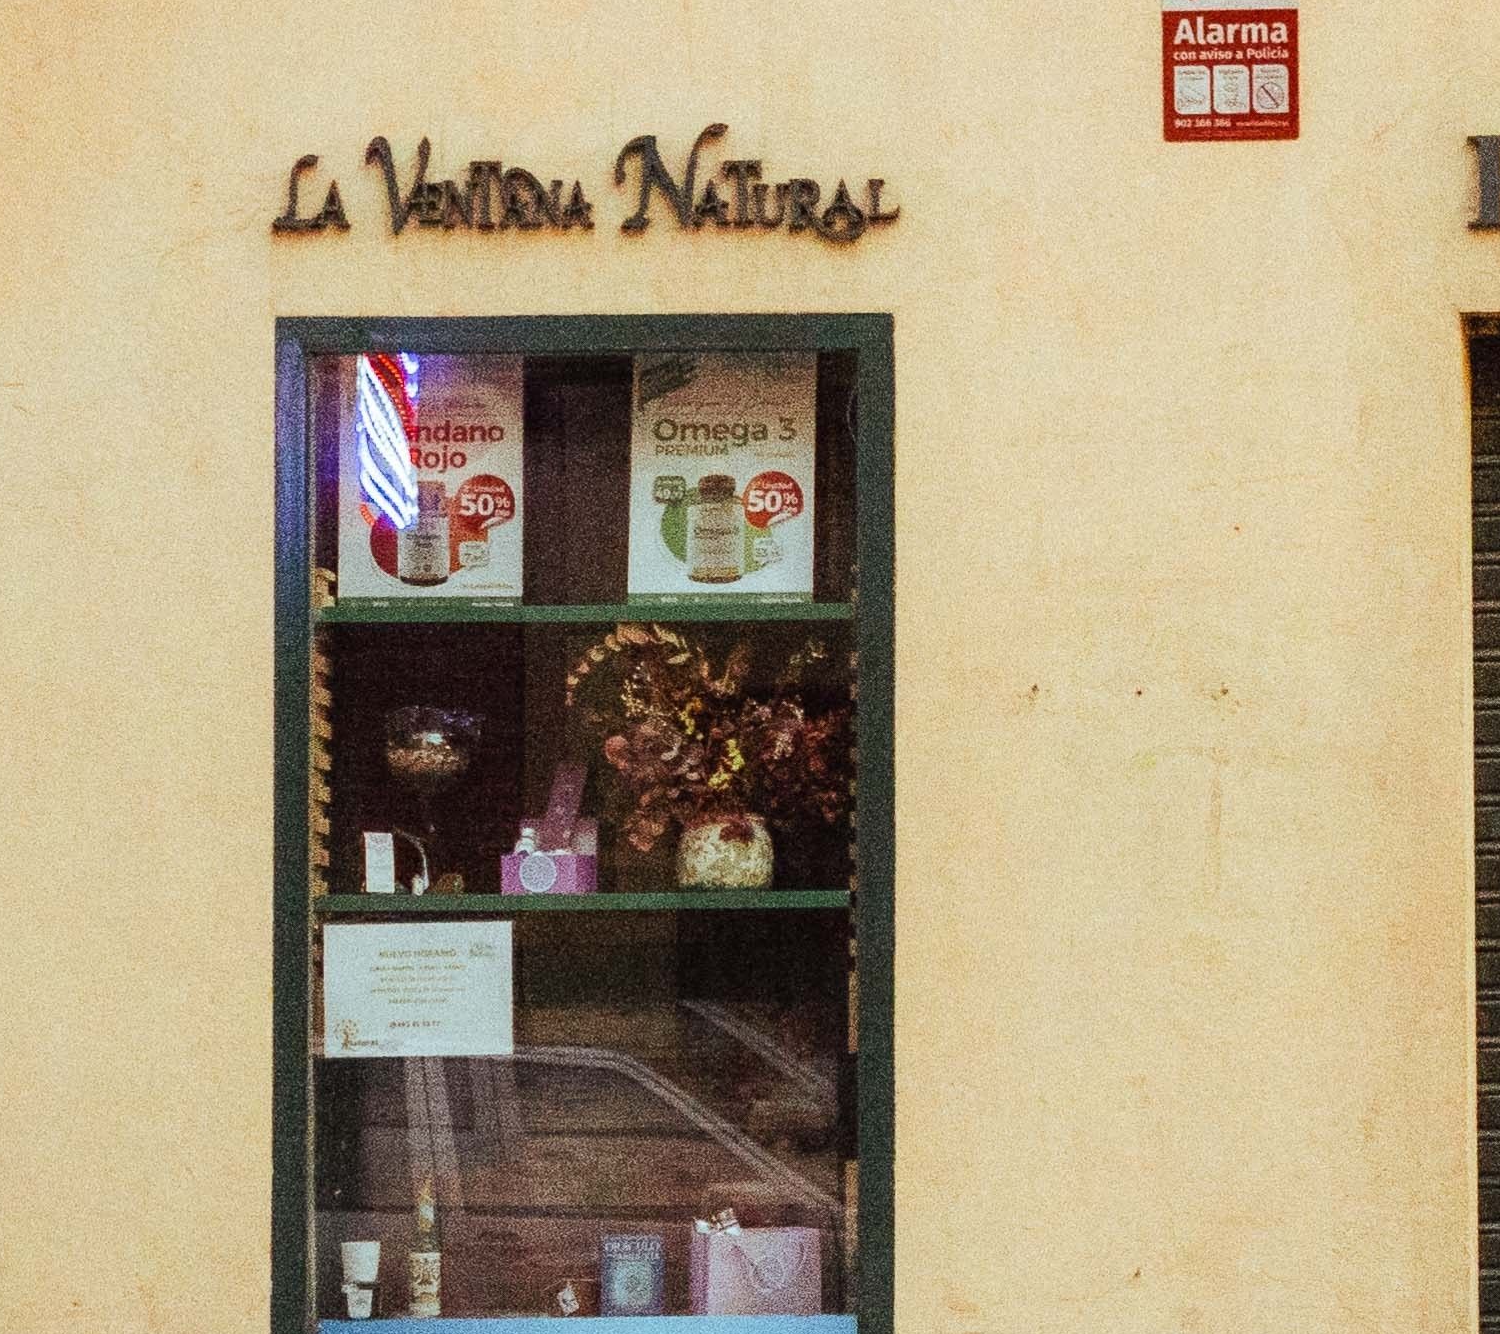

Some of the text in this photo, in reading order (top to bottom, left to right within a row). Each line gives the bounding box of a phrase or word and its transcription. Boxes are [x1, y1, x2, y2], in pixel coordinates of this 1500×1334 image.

[1173, 16, 1289, 45] Alarma
[1173, 50, 1197, 61] con
[1199, 47, 1232, 61] aviso
[1235, 49, 1244, 59] a
[408, 420, 504, 443] ndano
[654, 417, 797, 447] Omega 3
[655, 445, 729, 457] PREMIUM
